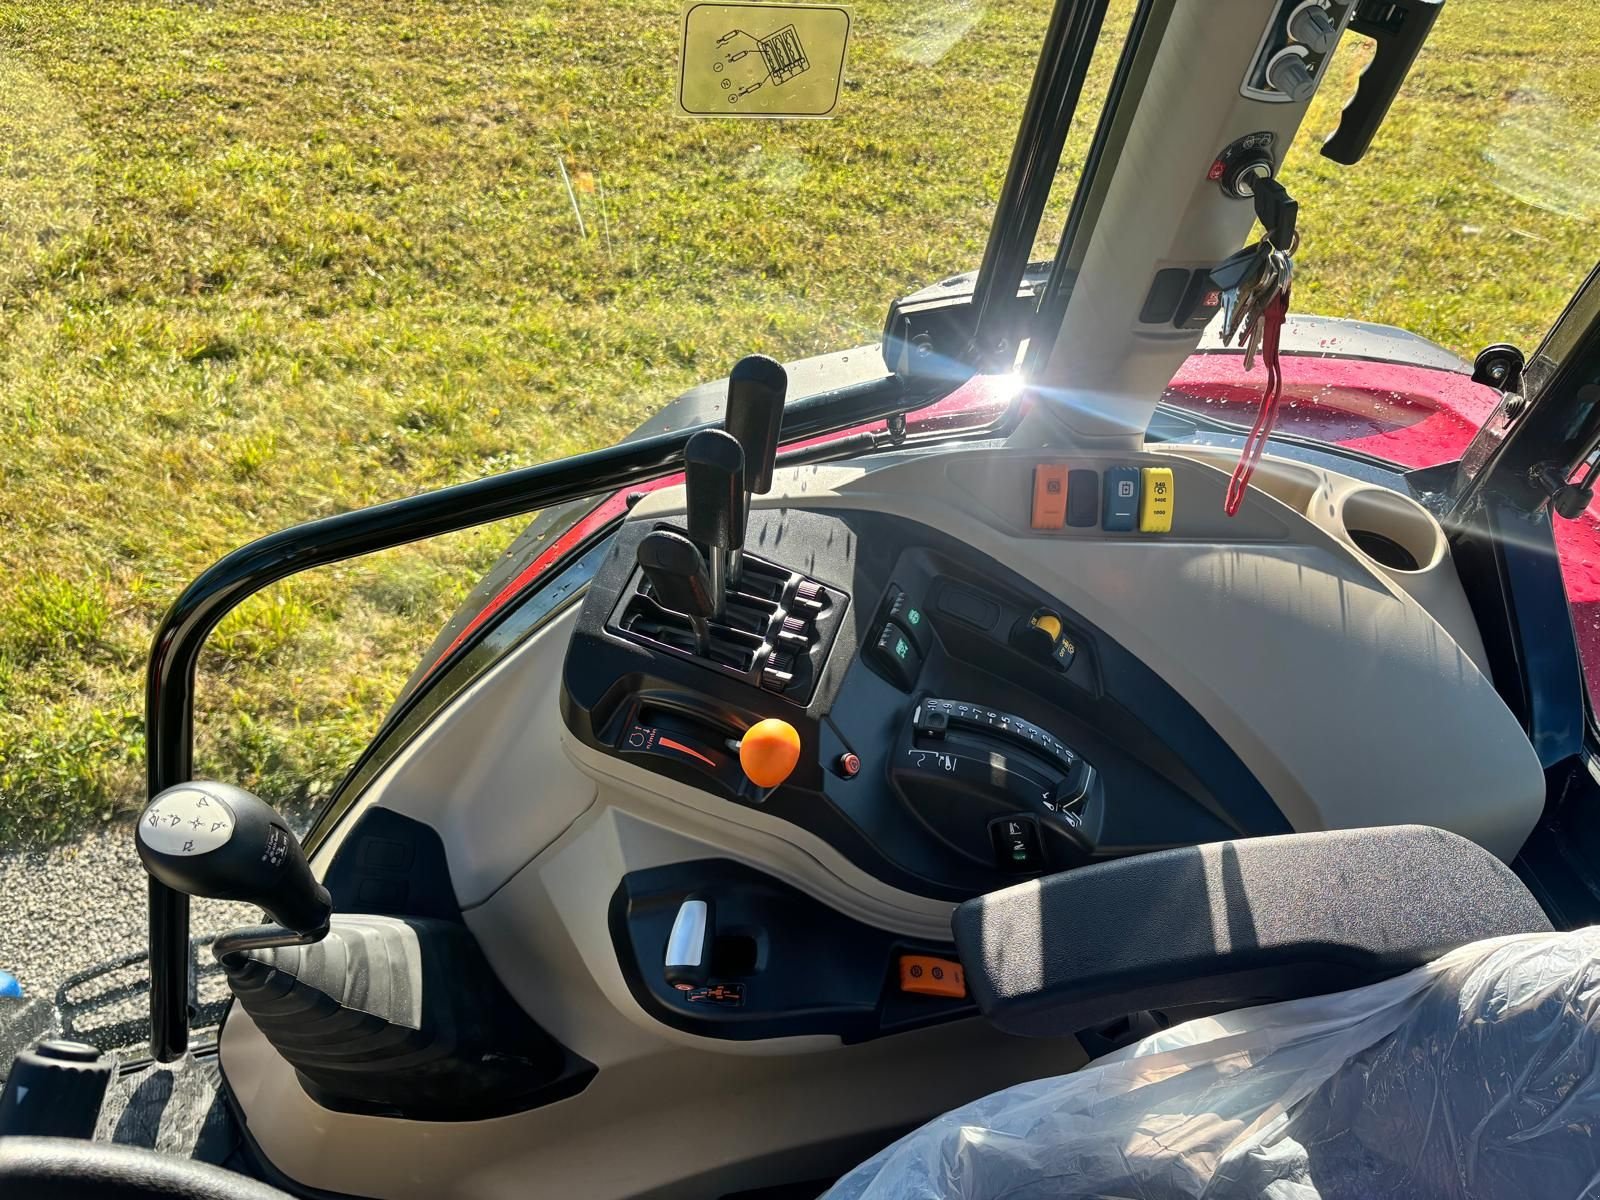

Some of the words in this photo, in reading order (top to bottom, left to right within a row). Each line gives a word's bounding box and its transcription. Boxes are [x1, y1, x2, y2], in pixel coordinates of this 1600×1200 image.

[927, 700, 938, 709] 10
[1001, 716, 1011, 724] 5
[1015, 721, 1025, 729] 4
[1042, 734, 1051, 743] 2
[1054, 742, 1064, 750] 1
[1065, 750, 1074, 758] 0
